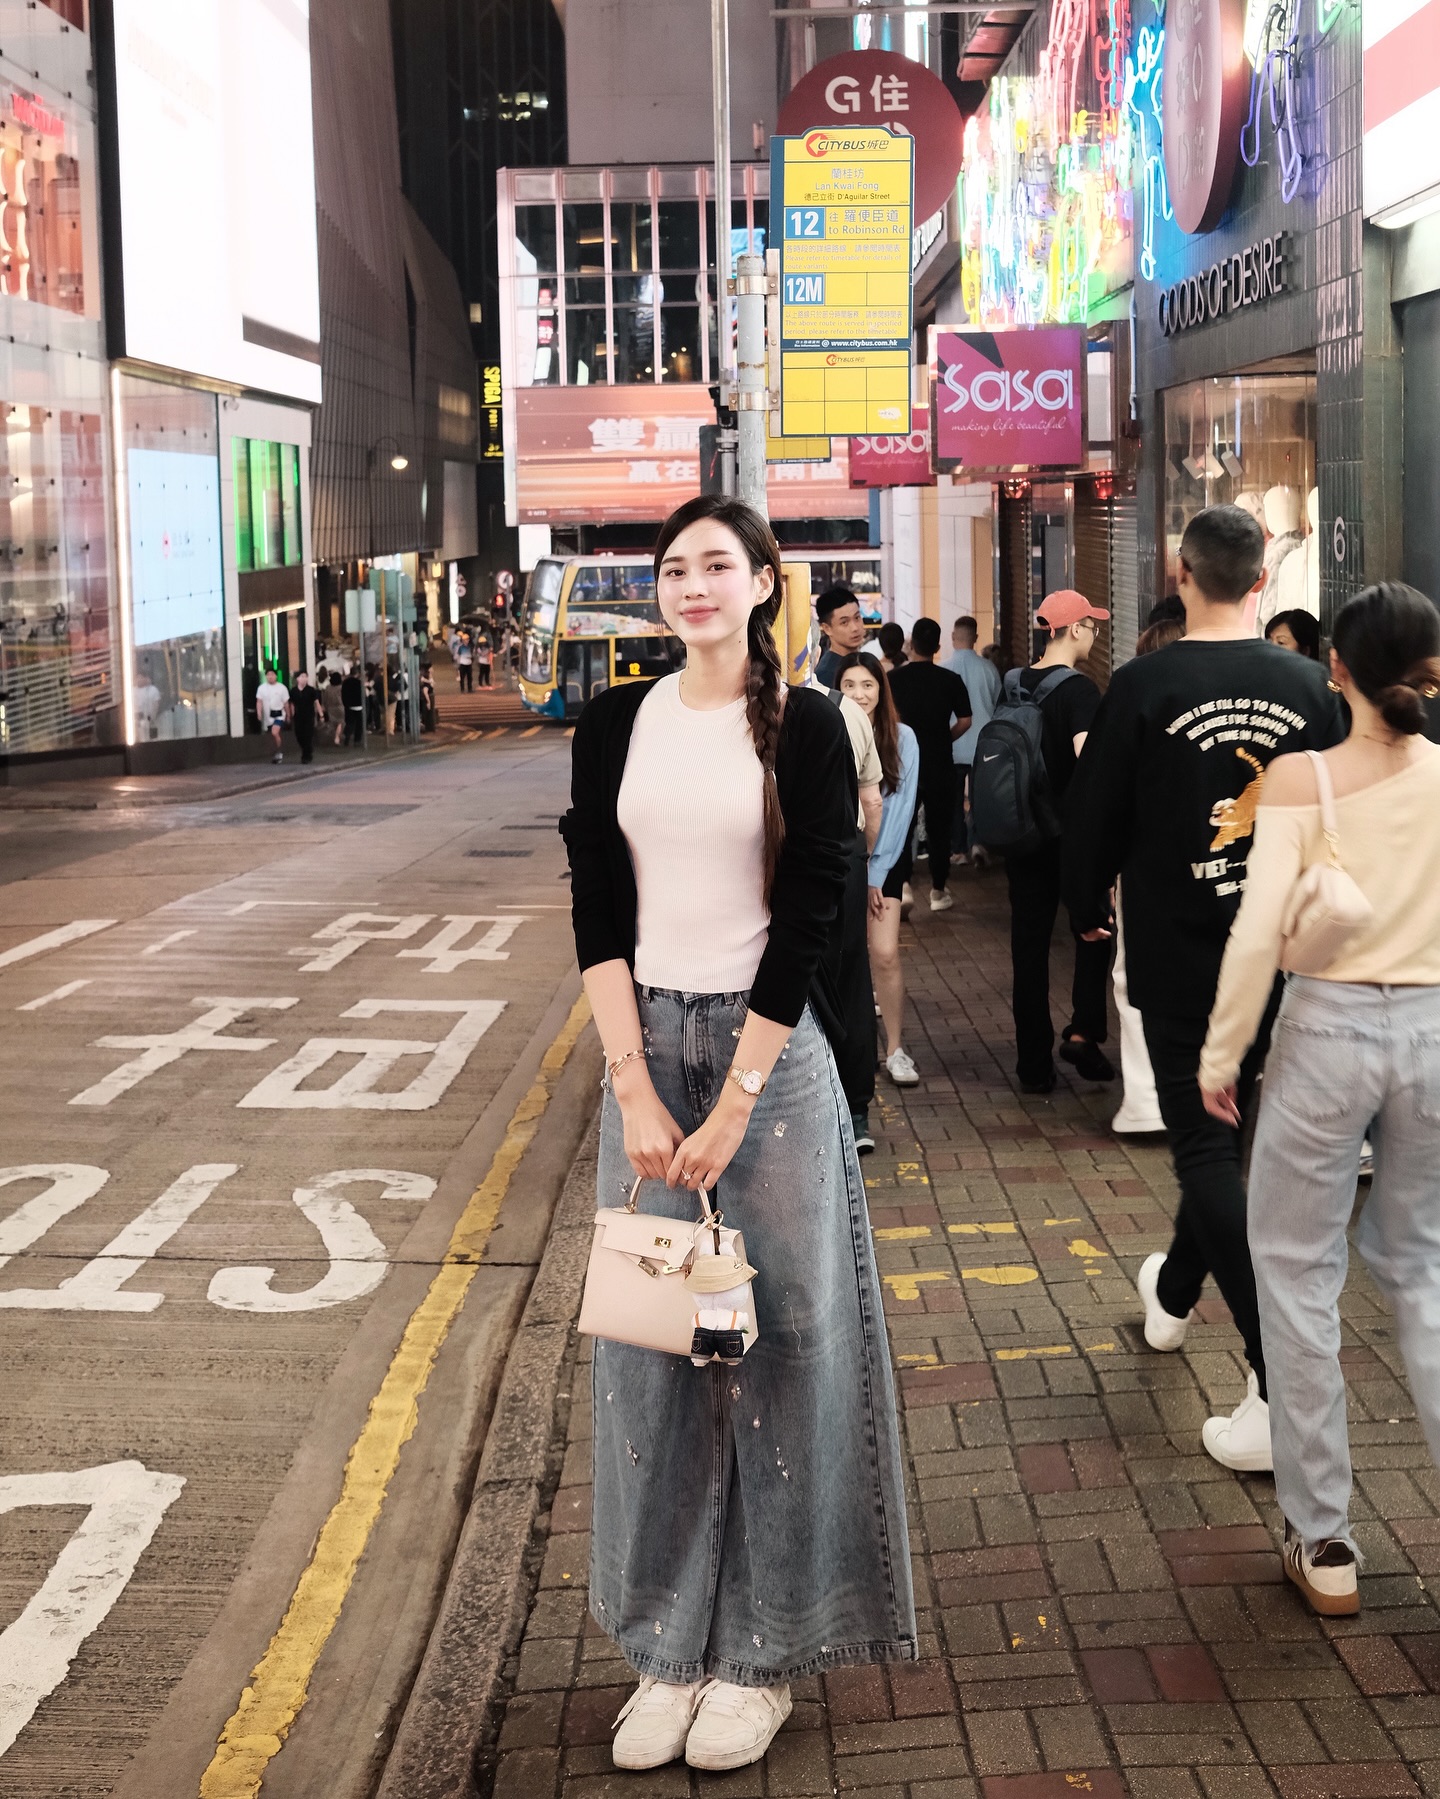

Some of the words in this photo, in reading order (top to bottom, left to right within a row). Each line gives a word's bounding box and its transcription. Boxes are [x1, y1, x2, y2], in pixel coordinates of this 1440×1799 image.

[818, 140, 866, 150] CITYBUS
[867, 140, 889, 150] 城巴
[831, 168, 865, 179] 蘭桂坊
[815, 182, 831, 190] Lan
[833, 182, 854, 190] Kwai
[857, 182, 879, 191] Fong
[837, 193, 868, 202] D'Aguilar
[791, 211, 819, 236] 12
[829, 212, 838, 223] 往
[844, 209, 899, 223] 羅便臣道
[829, 226, 838, 234] to
[842, 225, 889, 234] Robinson
[892, 225, 905, 234] Rd
[786, 277, 823, 302] 12M
[1159, 270, 1205, 336] GOODS
[1208, 259, 1228, 318] OF
[1232, 231, 1283, 309] DESIRE
[831, 340, 898, 348] www.citybus.com.hk
[484, 366, 501, 404] SPIGA
[951, 419, 990, 437] making
[992, 418, 1014, 437] life
[1016, 416, 1067, 436] beautiful
[1333, 516, 1346, 563] 6
[1234, 698, 1252, 710] GO
[1252, 698, 1269, 712] TO
[1268, 702, 1308, 731] HEAVEN
[1249, 714, 1290, 737] SERVED
[1215, 729, 1240, 744] TIME
[1251, 731, 1279, 749] HELL
